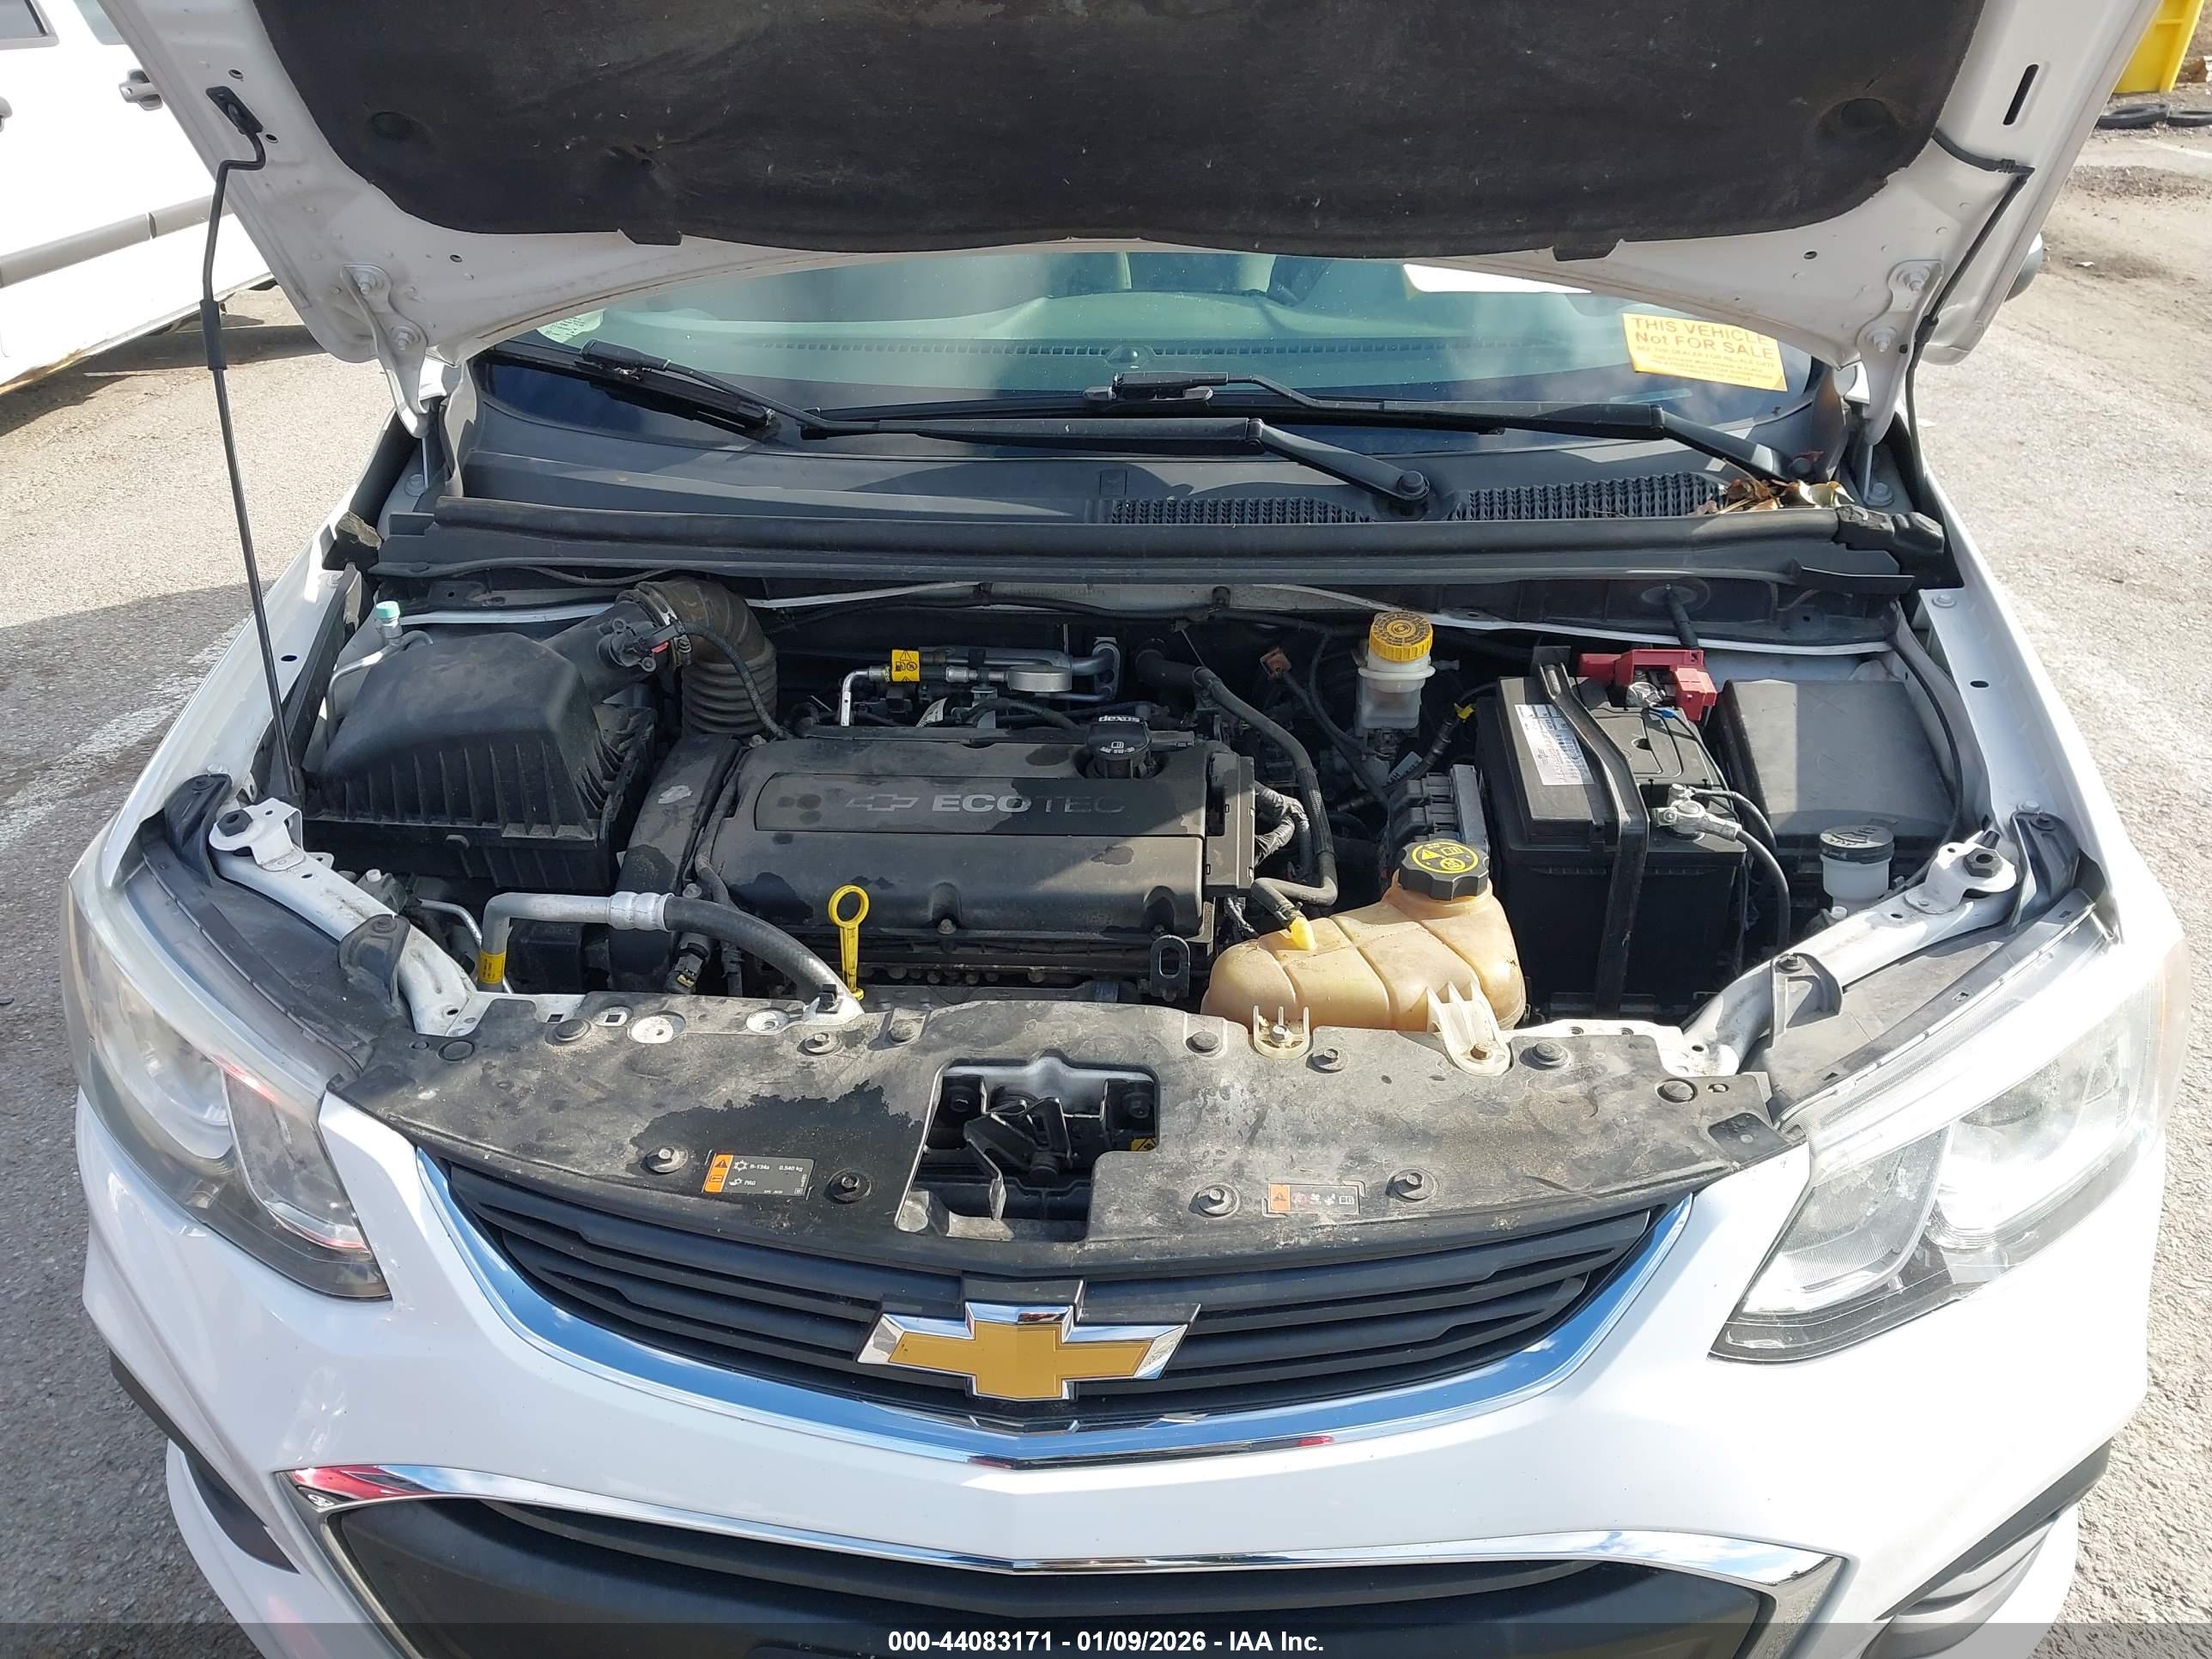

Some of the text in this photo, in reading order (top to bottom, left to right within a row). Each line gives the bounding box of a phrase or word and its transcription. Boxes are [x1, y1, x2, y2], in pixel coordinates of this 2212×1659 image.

[1632, 317, 1772, 345] THIS VEHICLE
[1635, 332, 1774, 360] Not FOR SALE
[931, 794, 1126, 814] ECOTEC
